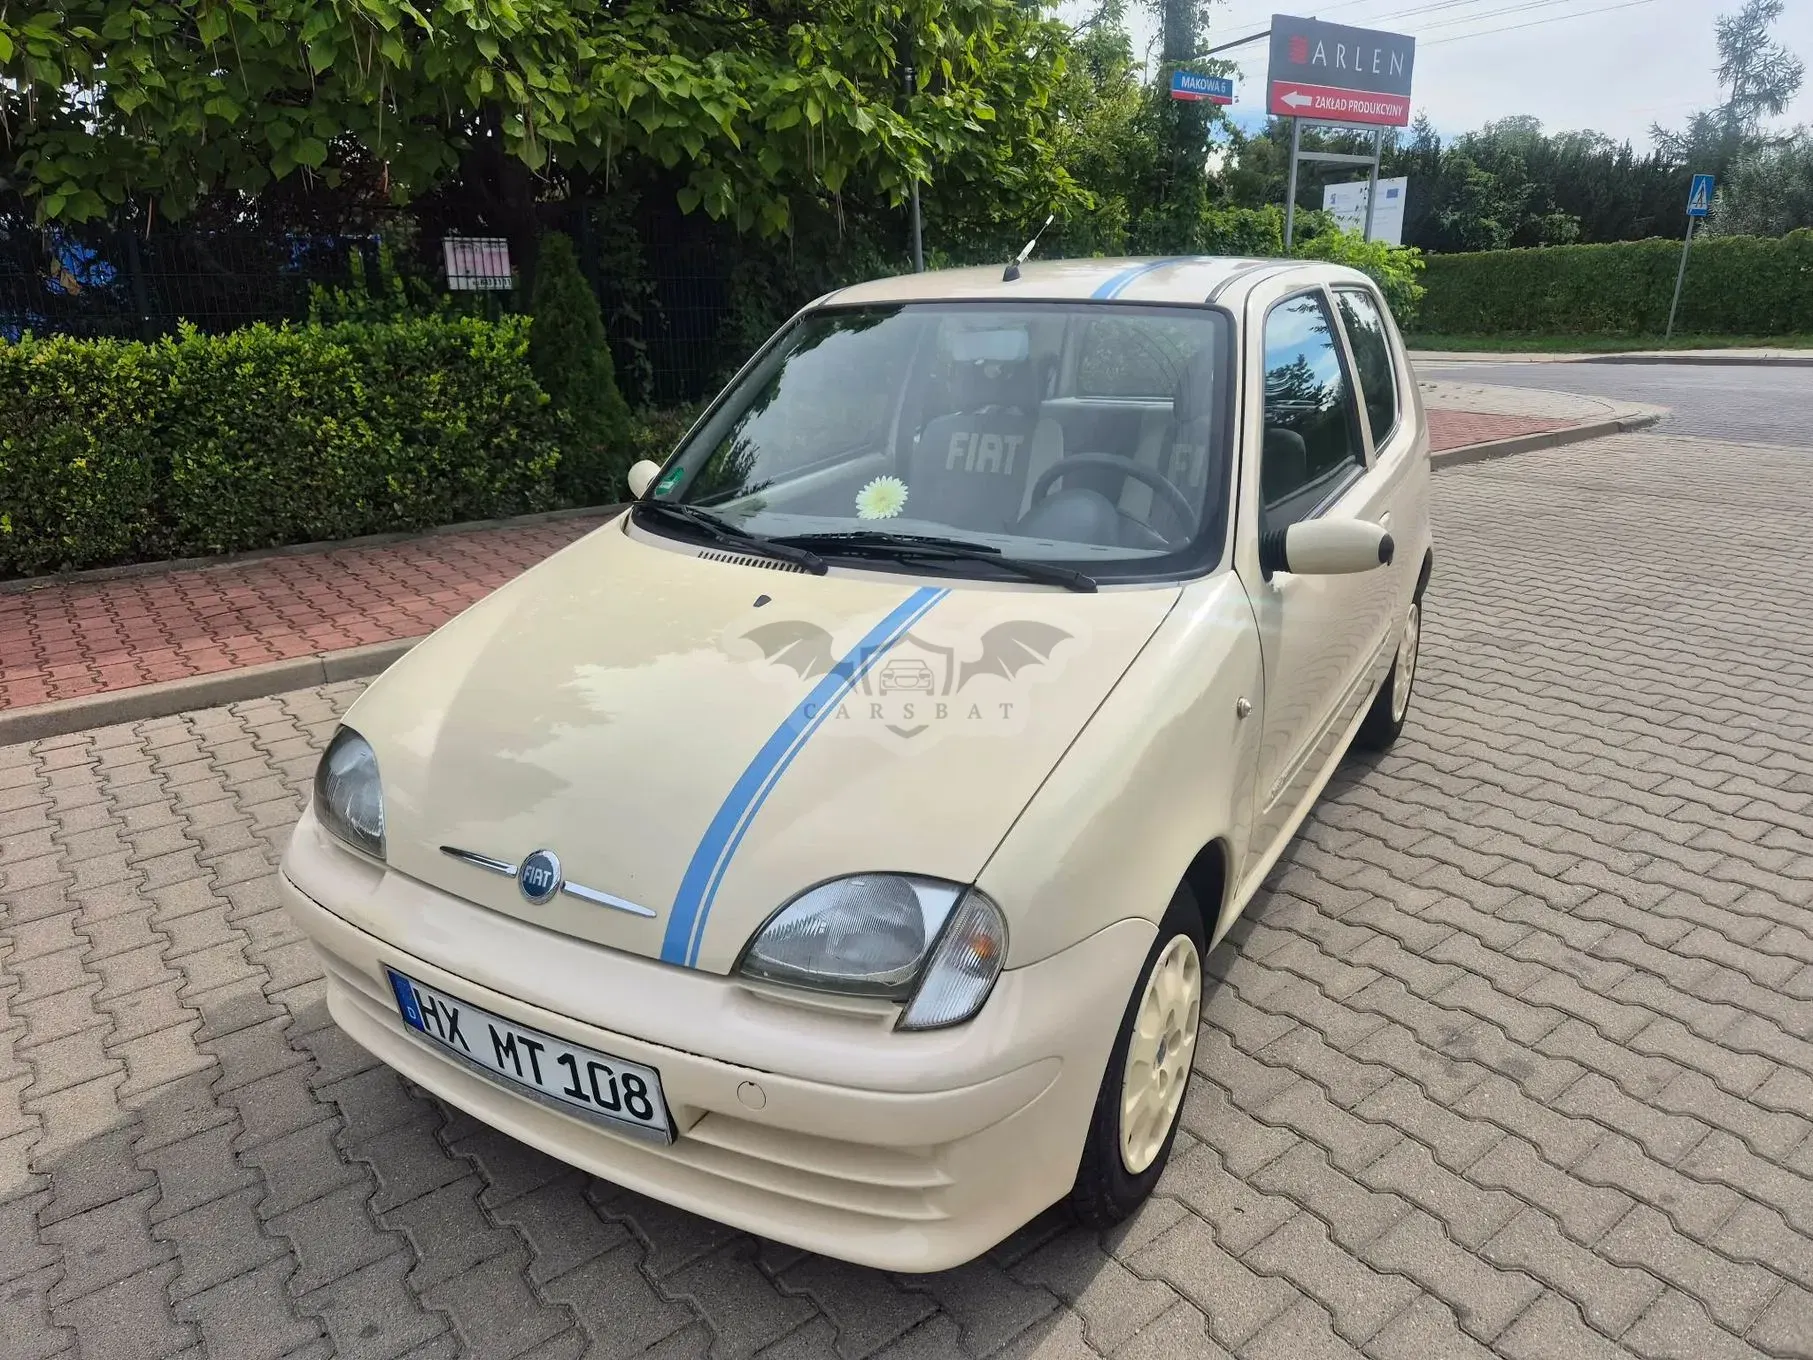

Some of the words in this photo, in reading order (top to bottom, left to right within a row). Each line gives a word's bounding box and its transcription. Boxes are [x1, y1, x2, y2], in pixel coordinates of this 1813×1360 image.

[1312, 40, 1404, 76] ARLEN
[1181, 76, 1220, 92] MAKOWA
[1221, 82, 1226, 93] 6
[1315, 96, 1347, 110] ZAKŁAD
[1348, 101, 1403, 117] PRODUKCYJNY
[945, 432, 1024, 475] FIAT
[523, 865, 551, 888] FIAT
[406, 1006, 417, 1020] D
[413, 988, 471, 1052] HX
[488, 1023, 545, 1086] MT
[557, 1053, 654, 1121] 108
